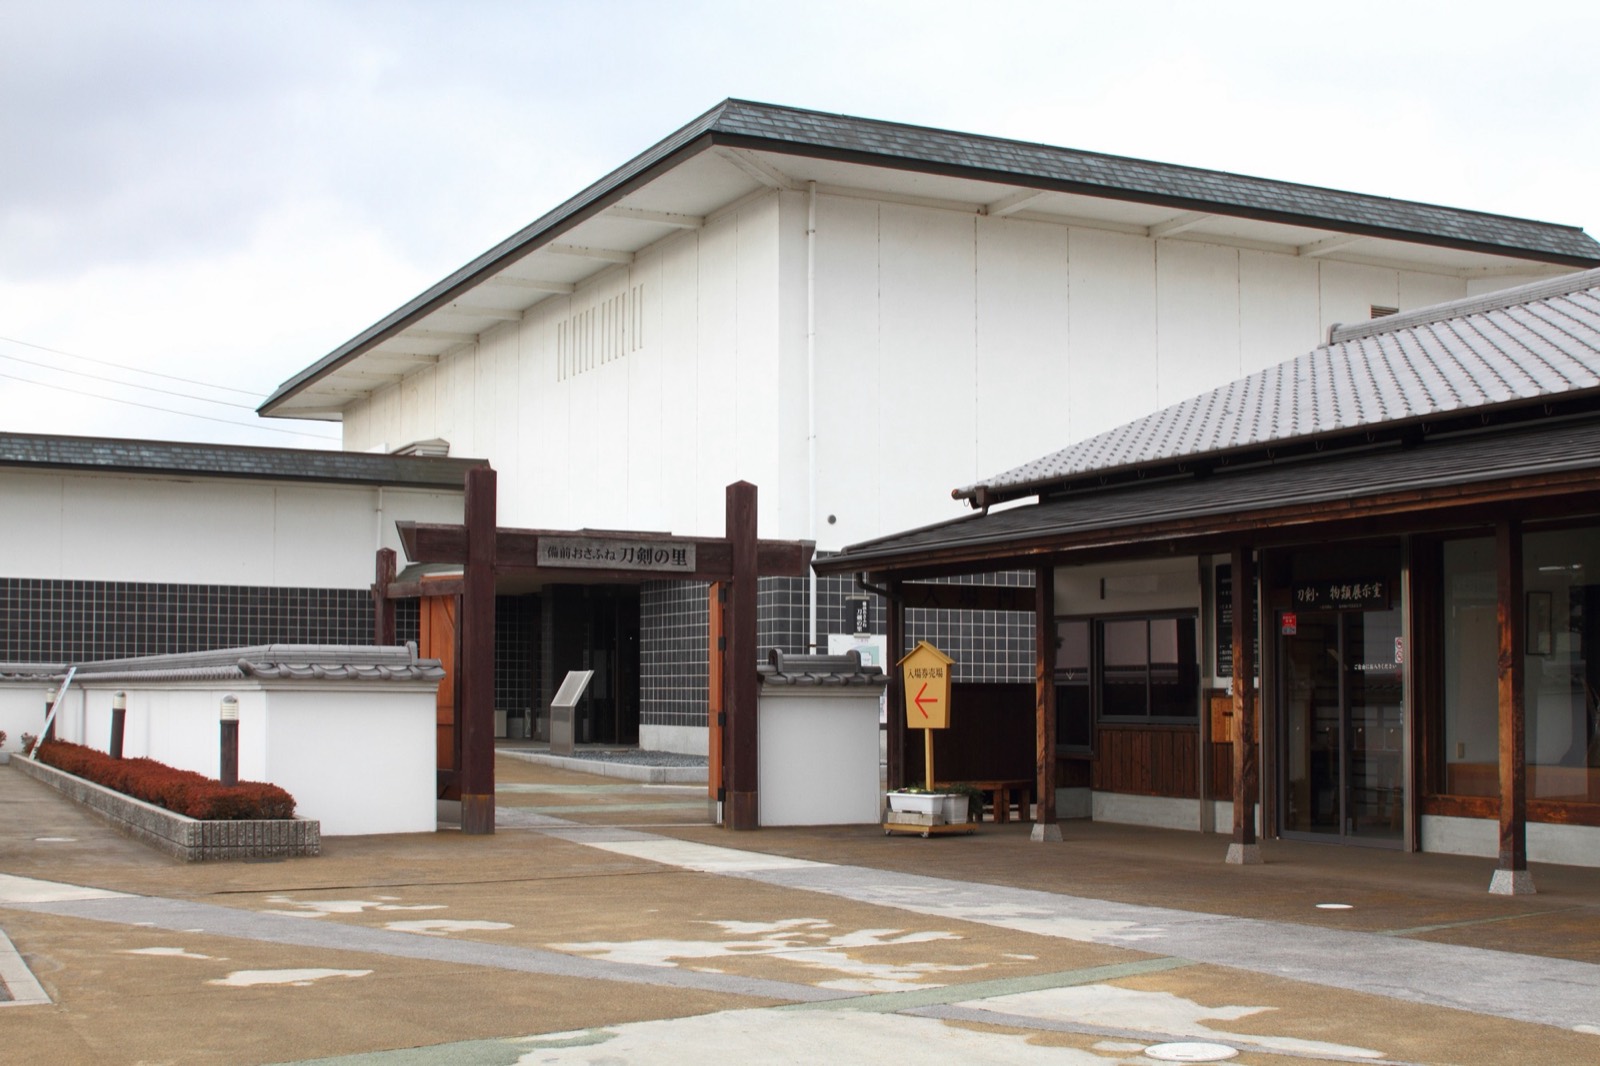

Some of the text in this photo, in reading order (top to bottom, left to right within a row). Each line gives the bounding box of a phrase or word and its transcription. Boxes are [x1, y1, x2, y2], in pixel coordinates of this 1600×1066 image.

[547, 545, 687, 566] 備前おさふね 刀剣の里
[907, 667, 943, 679] 入場券売場
